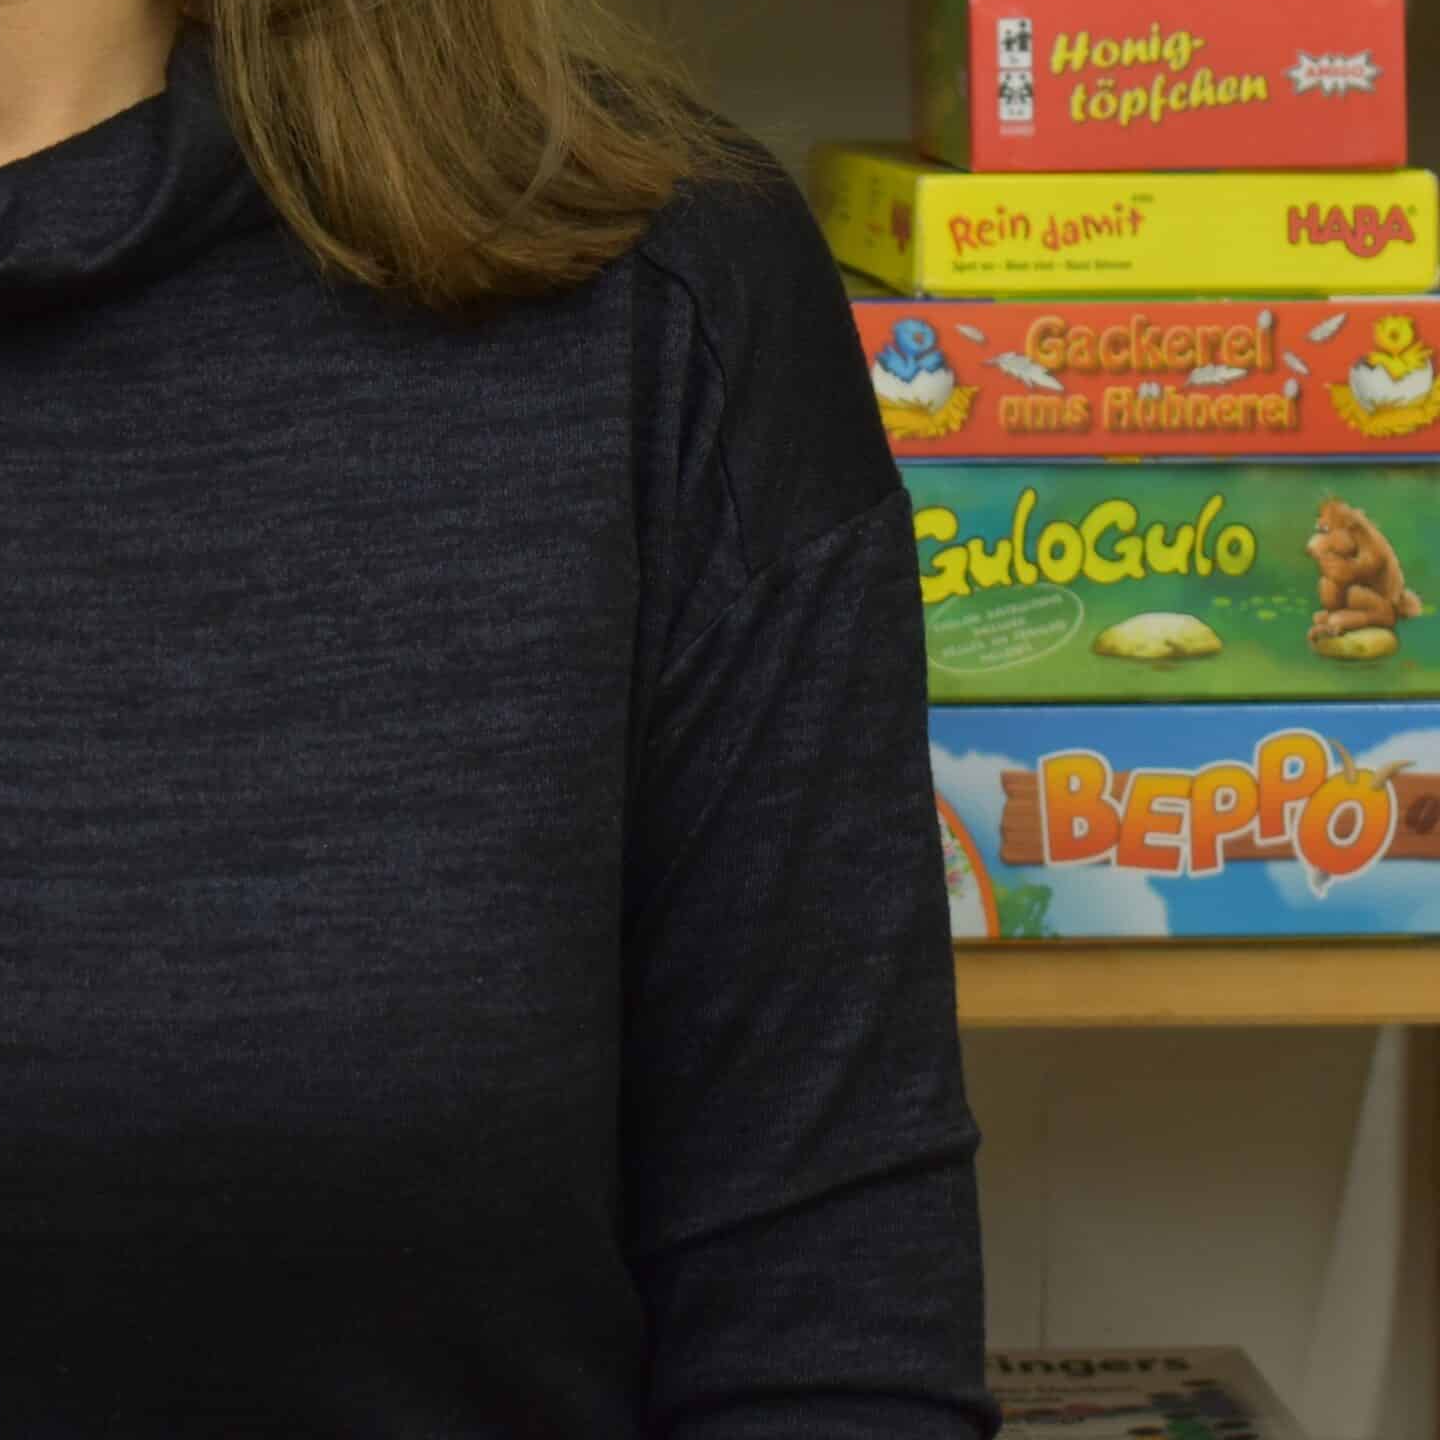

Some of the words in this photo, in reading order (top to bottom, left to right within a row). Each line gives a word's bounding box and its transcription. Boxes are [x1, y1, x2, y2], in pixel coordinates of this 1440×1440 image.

[1050, 21, 1205, 75] Honig-
[1068, 67, 1269, 127] töpfchen
[947, 203, 1032, 257] Rein
[1041, 201, 1146, 253] damit
[1287, 204, 1415, 259] HABA
[1024, 308, 1277, 373] Gackerei
[1036, 727, 1397, 882] BEPPO
